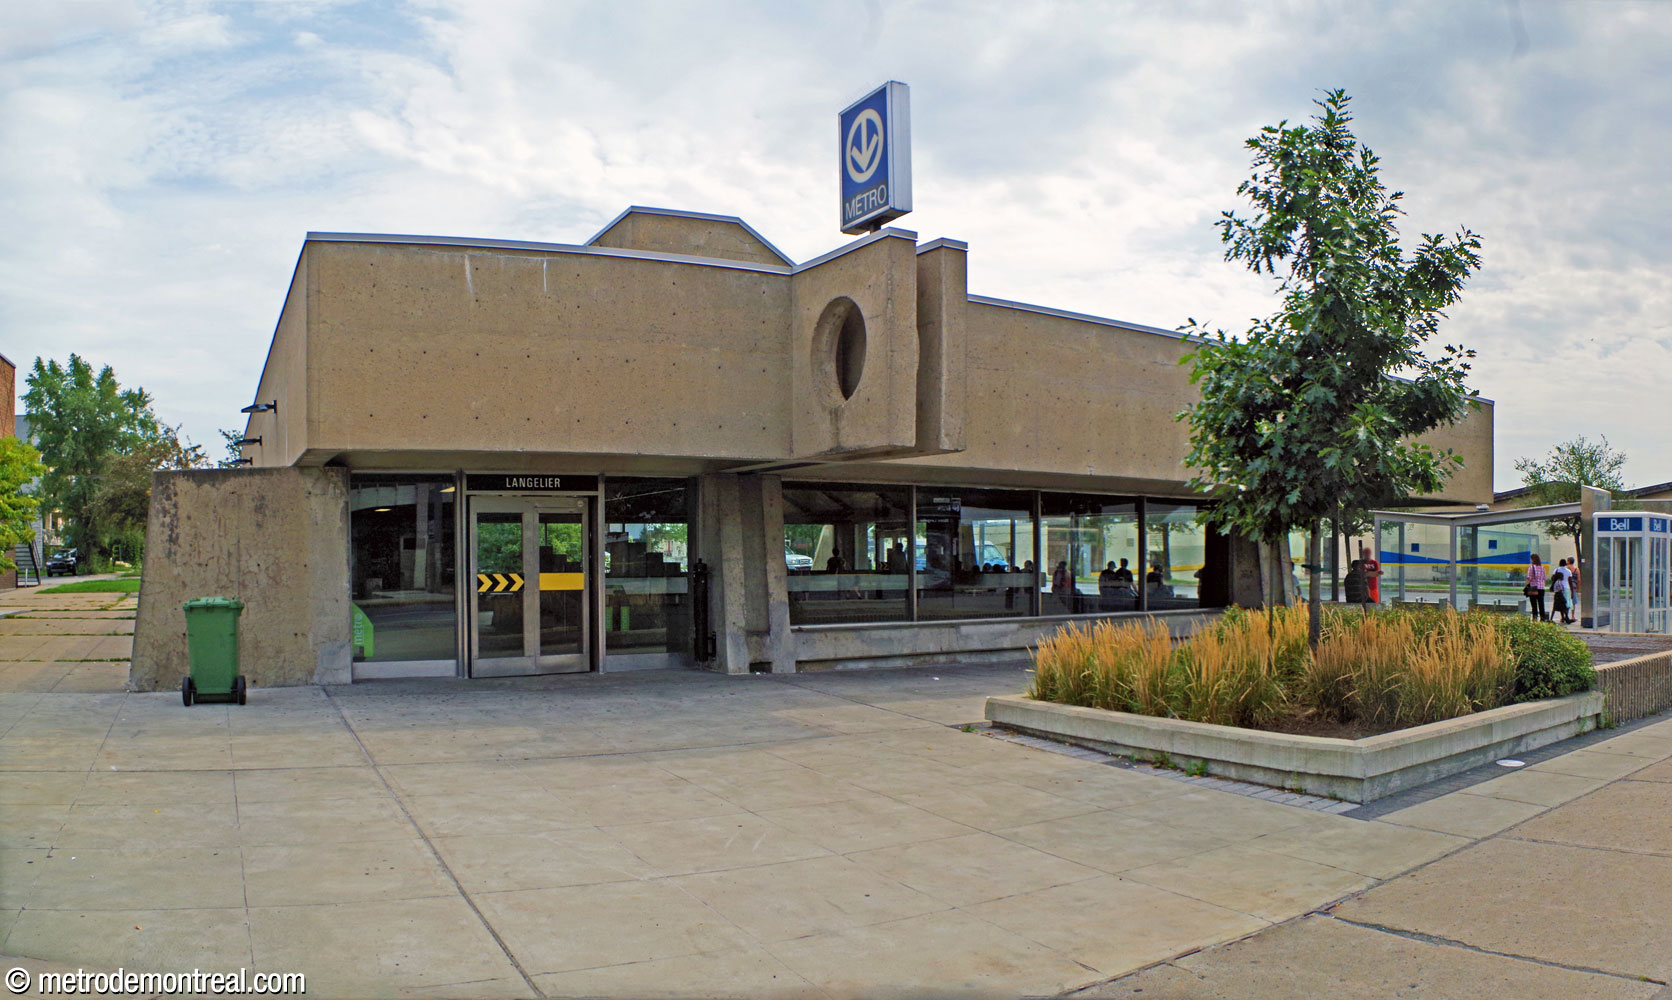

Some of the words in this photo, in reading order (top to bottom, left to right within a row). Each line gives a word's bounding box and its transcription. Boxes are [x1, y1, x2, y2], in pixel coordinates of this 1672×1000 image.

[506, 477, 561, 488] LANGELIER
[1610, 518, 1630, 531] Bell
[1653, 519, 1662, 532] Bell
